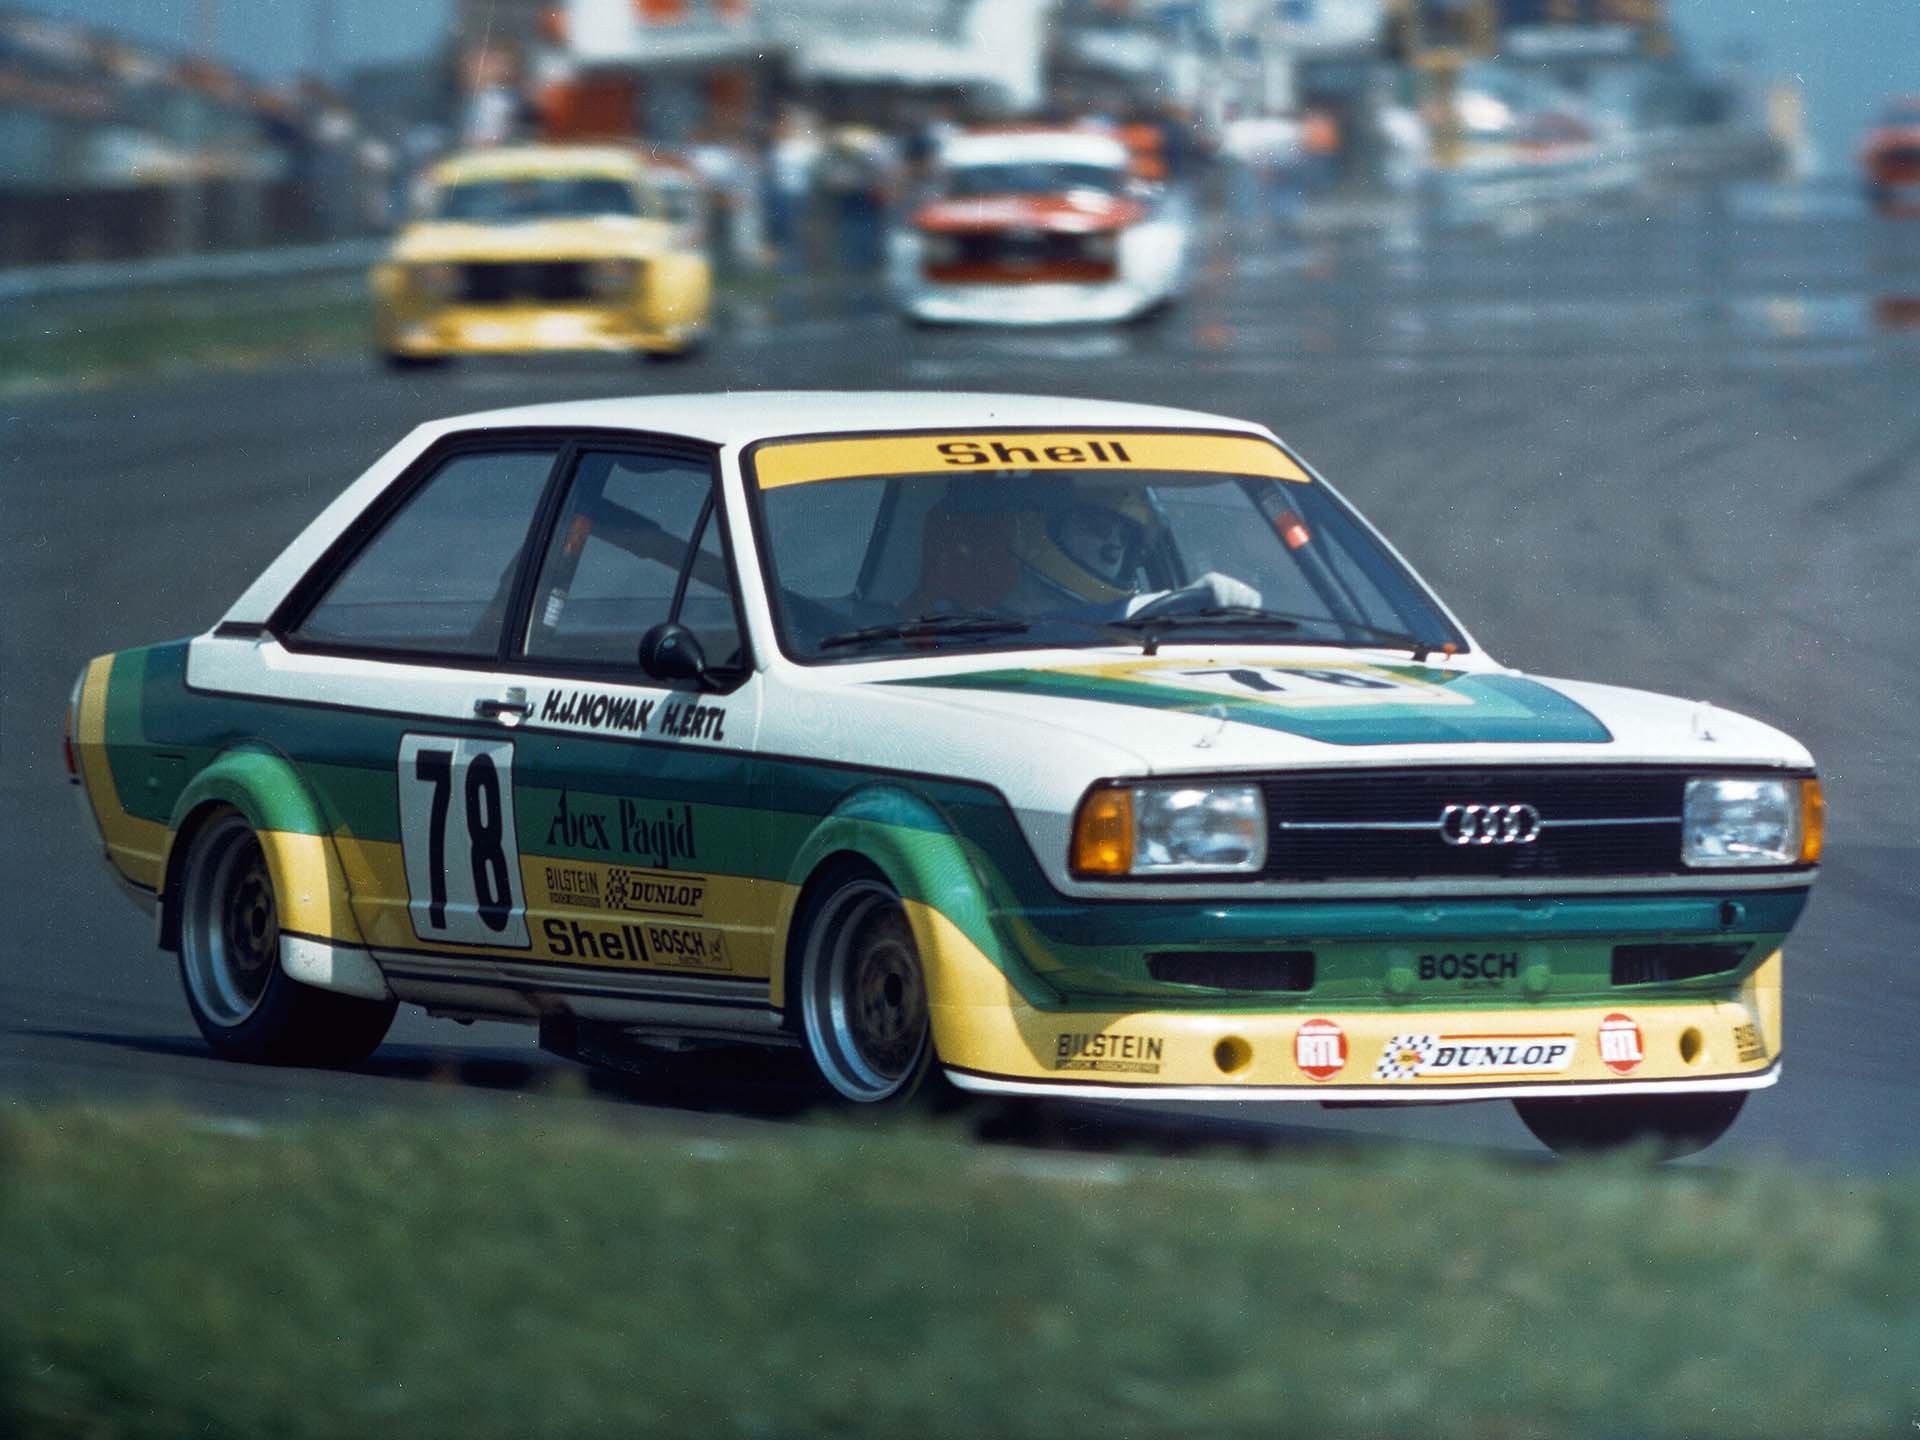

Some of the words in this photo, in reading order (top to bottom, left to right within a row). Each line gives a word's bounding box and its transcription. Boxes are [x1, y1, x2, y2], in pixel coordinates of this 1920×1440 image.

[937, 441, 1132, 465] Shell
[1178, 668, 1399, 692] 78
[659, 703, 726, 741] H.ERTL
[415, 749, 513, 932] 78
[618, 798, 696, 869] Pagid
[545, 867, 600, 895] BILSTEIN
[629, 881, 704, 907] DUNLOP
[543, 918, 649, 962] Shell
[651, 928, 706, 956] BOSCH
[1419, 952, 1520, 980] BOSCH
[1057, 1033, 1163, 1060] BILSTEIN
[1431, 1045, 1567, 1067] DUNLOP
